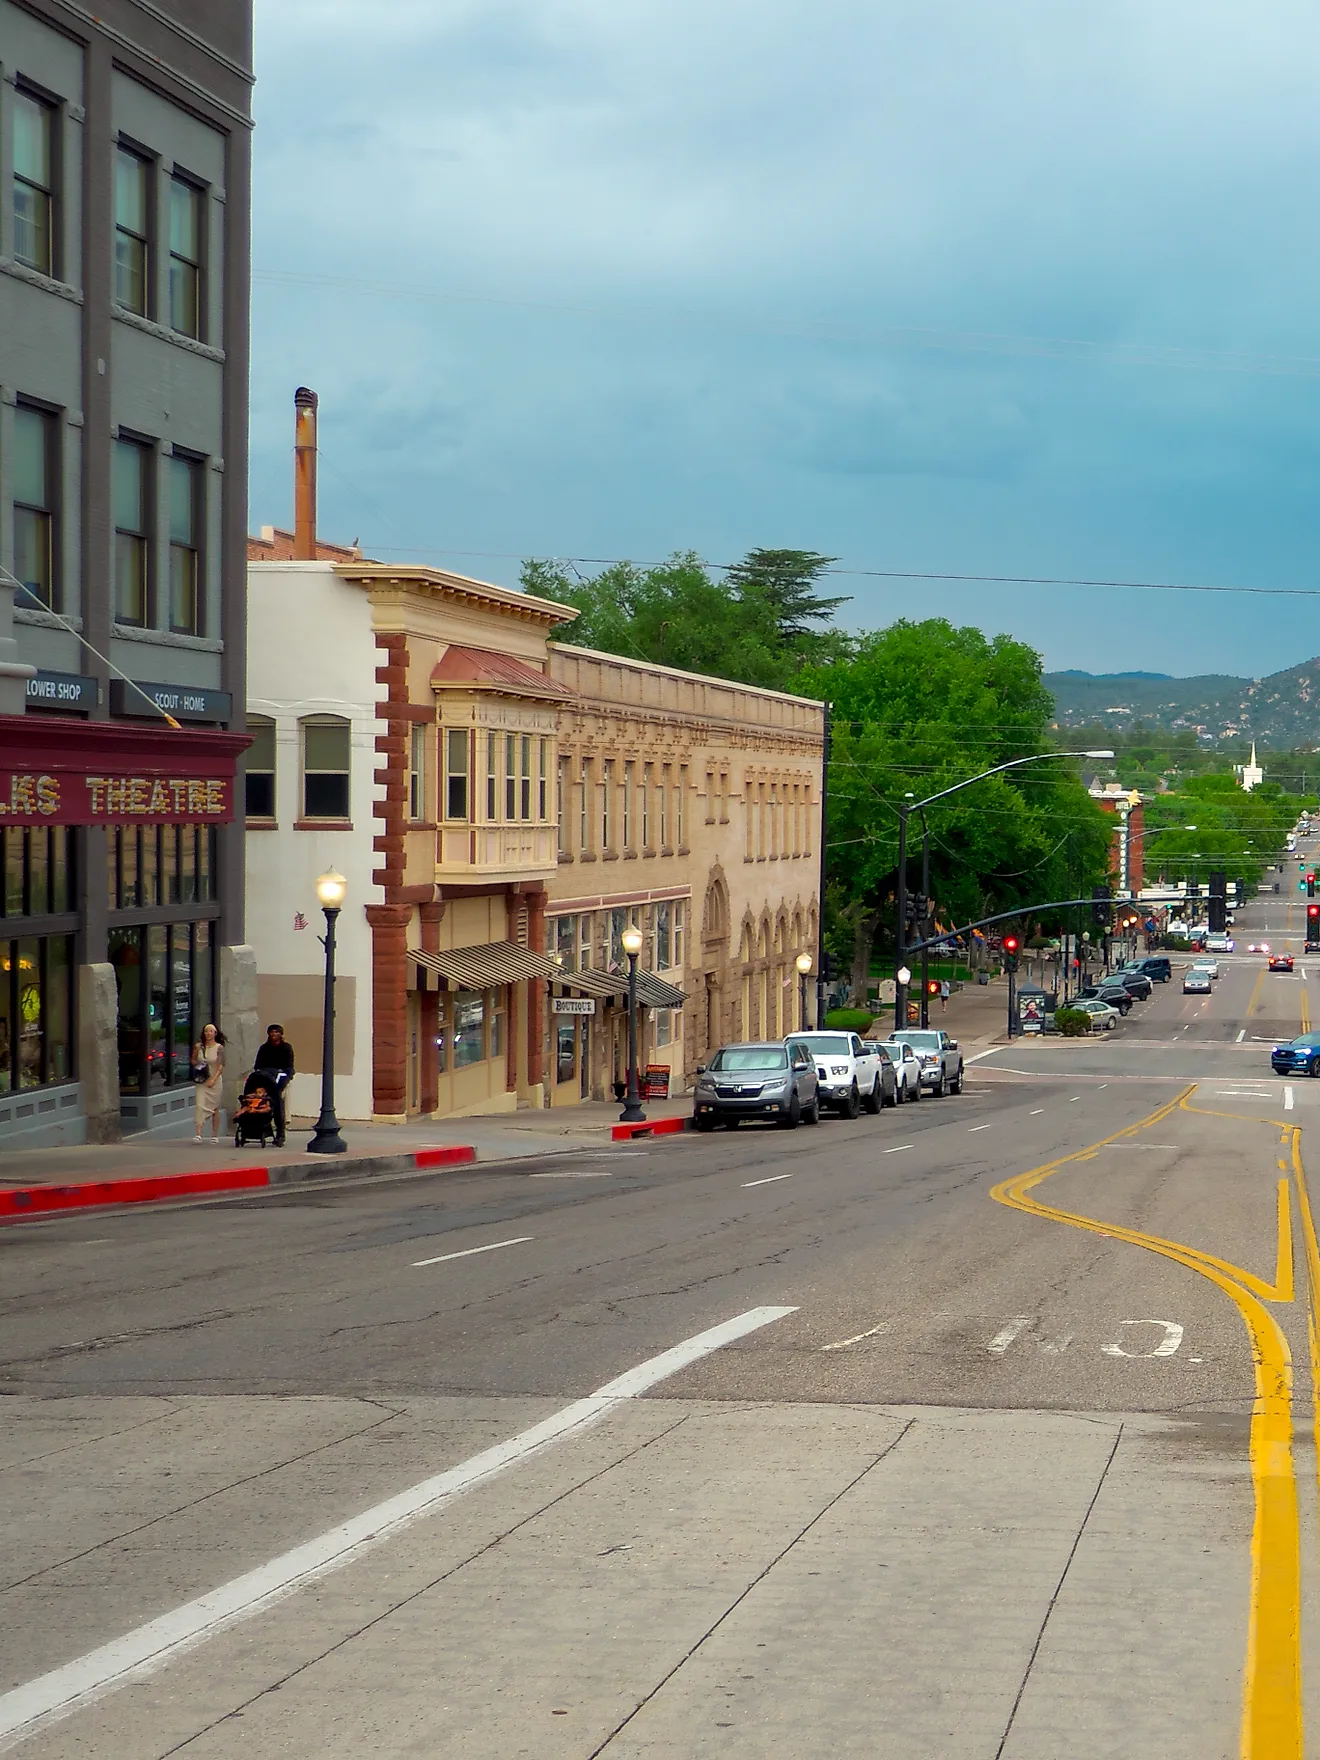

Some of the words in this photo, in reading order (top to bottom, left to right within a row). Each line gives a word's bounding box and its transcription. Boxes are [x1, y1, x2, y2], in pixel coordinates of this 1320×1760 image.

[26, 679, 56, 699] LOWER
[58, 682, 82, 701] SHOP
[154, 693, 180, 710] SCOUT
[184, 697, 205, 713] HOME
[86, 777, 226, 815] THEATRE
[555, 1000, 591, 1012] BOUTIQUE
